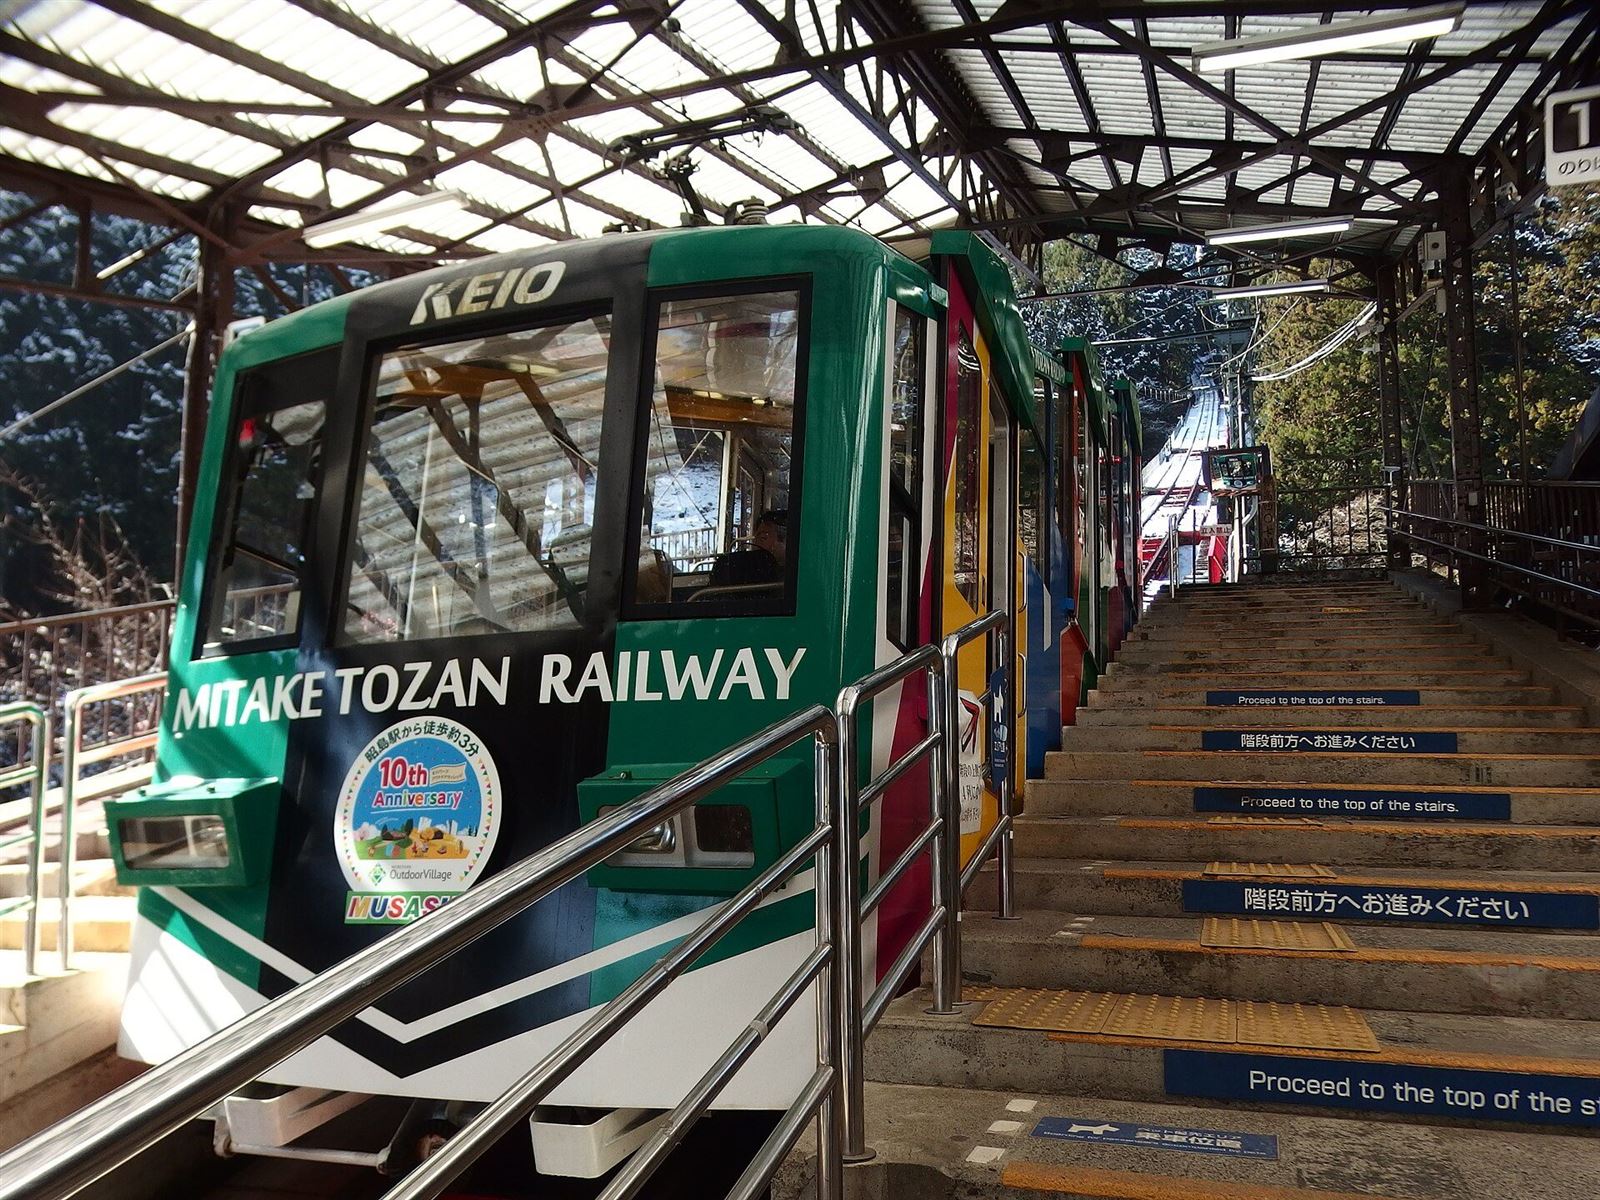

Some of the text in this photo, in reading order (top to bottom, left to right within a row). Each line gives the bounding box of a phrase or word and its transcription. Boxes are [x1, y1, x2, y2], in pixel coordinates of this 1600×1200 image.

[1568, 101, 1590, 148] 1
[409, 261, 567, 326] KEIO
[172, 647, 808, 732] MITAKE TOZAN RAILWAY
[1238, 696, 1386, 706] Proceed to the top of the stairs.
[364, 720, 479, 763] 昭島駅から徒歩約3分
[1240, 734, 1416, 749] 階段前方へお進みください
[379, 757, 428, 787] 10th
[373, 790, 463, 810] Anniversary
[1241, 796, 1459, 812] Proceed to the top of the stairs.
[347, 895, 455, 919] MUSAS
[1244, 888, 1530, 920] 階段前方へお進みください
[1249, 1070, 1350, 1097] Proceed
[1358, 1079, 1384, 1100] to
[1392, 1082, 1435, 1104] the
[1442, 1086, 1485, 1110] top
[1493, 1090, 1520, 1110] of
[1527, 1091, 1571, 1114] the
